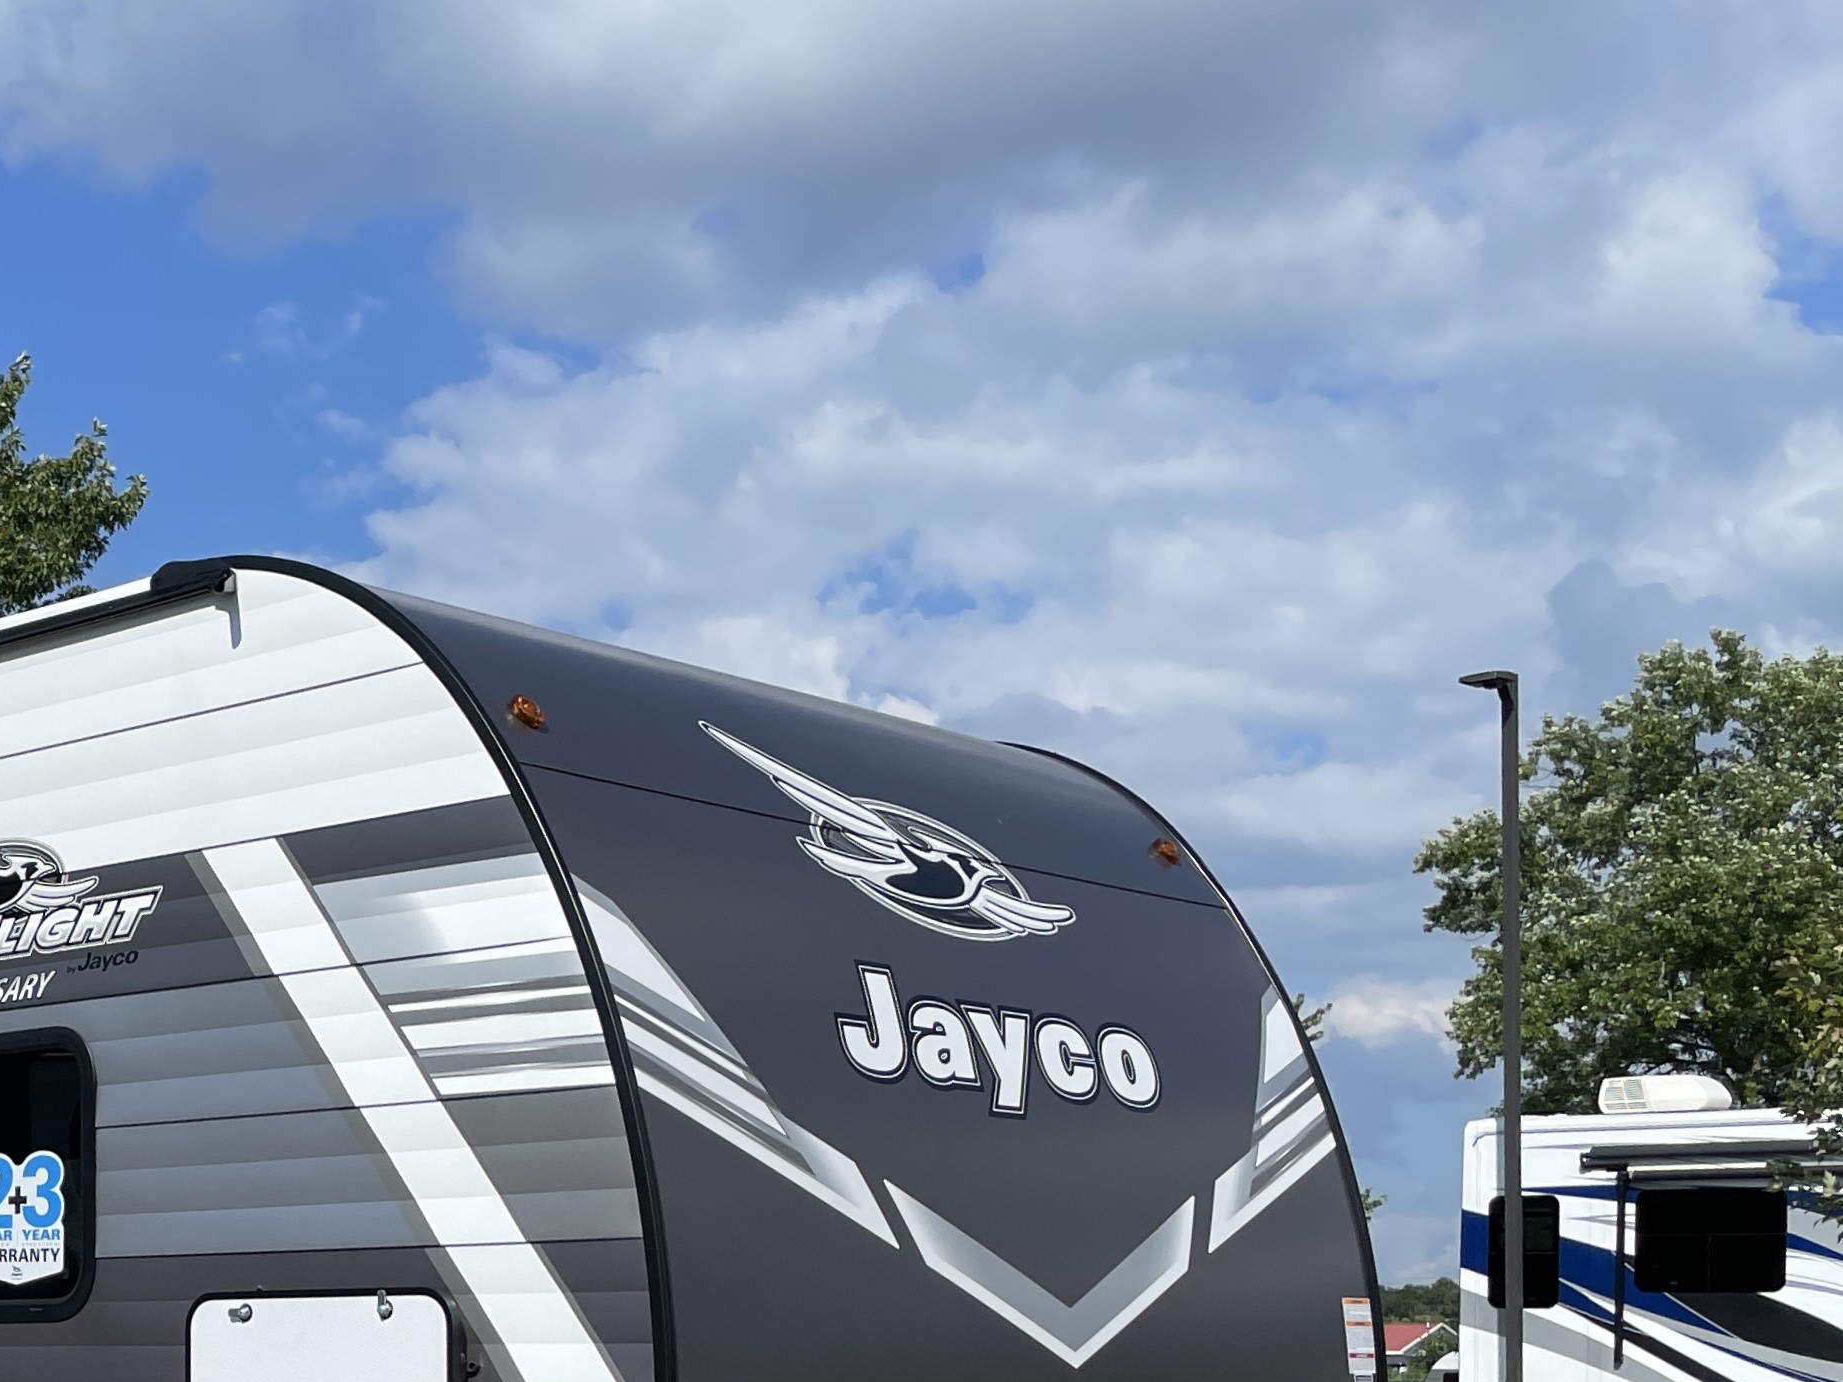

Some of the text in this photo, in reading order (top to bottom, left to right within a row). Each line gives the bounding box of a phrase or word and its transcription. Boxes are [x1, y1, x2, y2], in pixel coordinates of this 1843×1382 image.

[77, 949, 139, 974] Jayco
[835, 961, 1161, 1118] Jayco
[22, 1229, 61, 1241] YEAR
